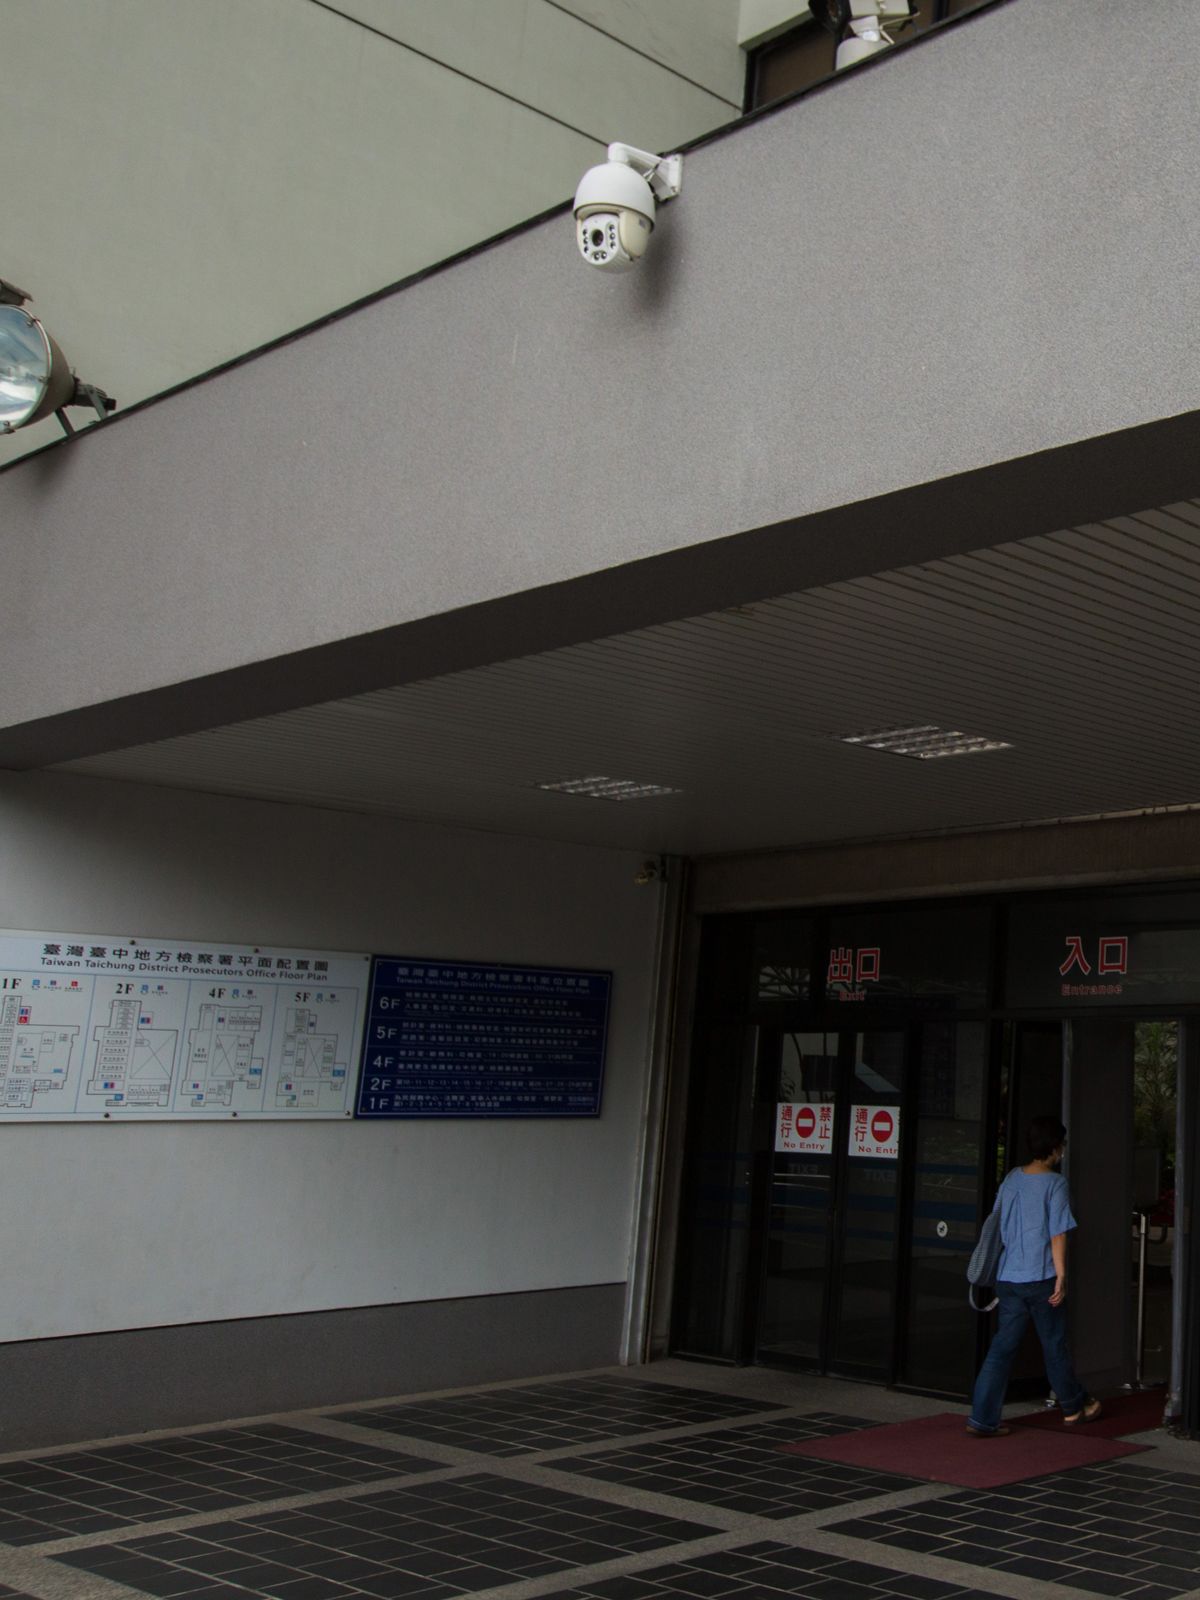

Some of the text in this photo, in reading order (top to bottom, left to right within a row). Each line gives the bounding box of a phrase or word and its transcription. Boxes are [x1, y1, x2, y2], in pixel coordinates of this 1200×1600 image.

[43, 944, 329, 971] 臺灣臺中地方檢察署平面配置圖
[1059, 936, 1128, 976] 入口
[41, 957, 328, 981] Taiwan Taichung District Prosecutors Office Floor Plan
[827, 946, 881, 984] 出口
[115, 983, 135, 994] 2F
[209, 988, 226, 999] 4F
[1060, 983, 1123, 996] Entrance
[295, 992, 311, 1003] 5F
[379, 996, 401, 1010] 6F
[376, 1025, 398, 1040] 5F
[372, 1055, 395, 1068] 4F
[370, 1077, 392, 1091] 2F
[369, 1096, 390, 1110] 1F
[781, 1105, 793, 1138] 通行
[819, 1106, 831, 1139] 禁止
[855, 1108, 868, 1142] 通行
[800, 1142, 825, 1151] Entry
[858, 1145, 898, 1154] No Entr
